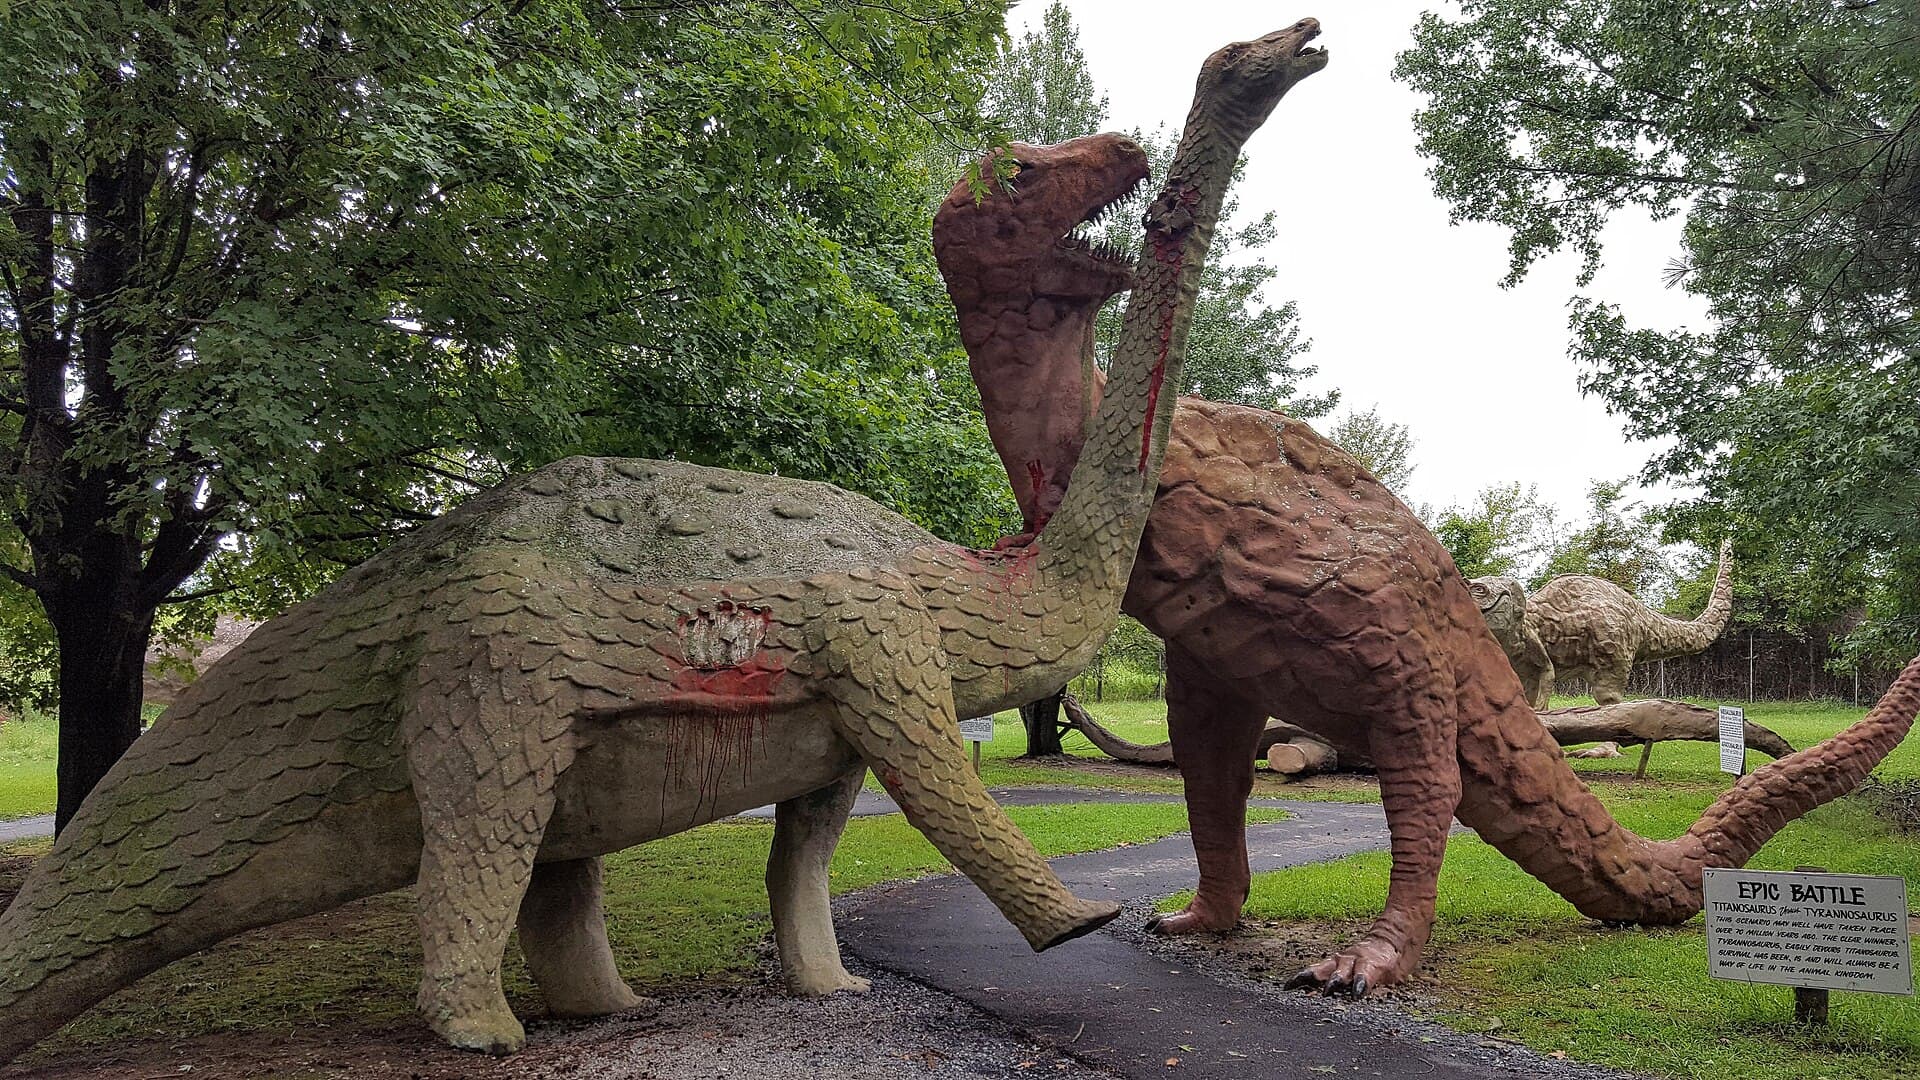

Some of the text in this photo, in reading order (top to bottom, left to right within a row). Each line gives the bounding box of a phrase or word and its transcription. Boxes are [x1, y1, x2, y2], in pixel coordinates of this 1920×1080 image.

[1737, 881, 1866, 906] EPIC BATTLE
[1712, 902, 1776, 914] TITANOSAURUS
[1804, 908, 1897, 922] TYRANNOSAURUS
[1717, 938, 1782, 950] TYRANNOSAURUS,
[1813, 945, 1840, 953] DEVOURS
[1864, 938, 1899, 947] WINNER,
[1718, 950, 1752, 958] SURVIVAL
[1846, 960, 1876, 968] ALWAYS
[1799, 968, 1831, 976] ANIMAL
[1835, 970, 1876, 980] KINGDOM.
